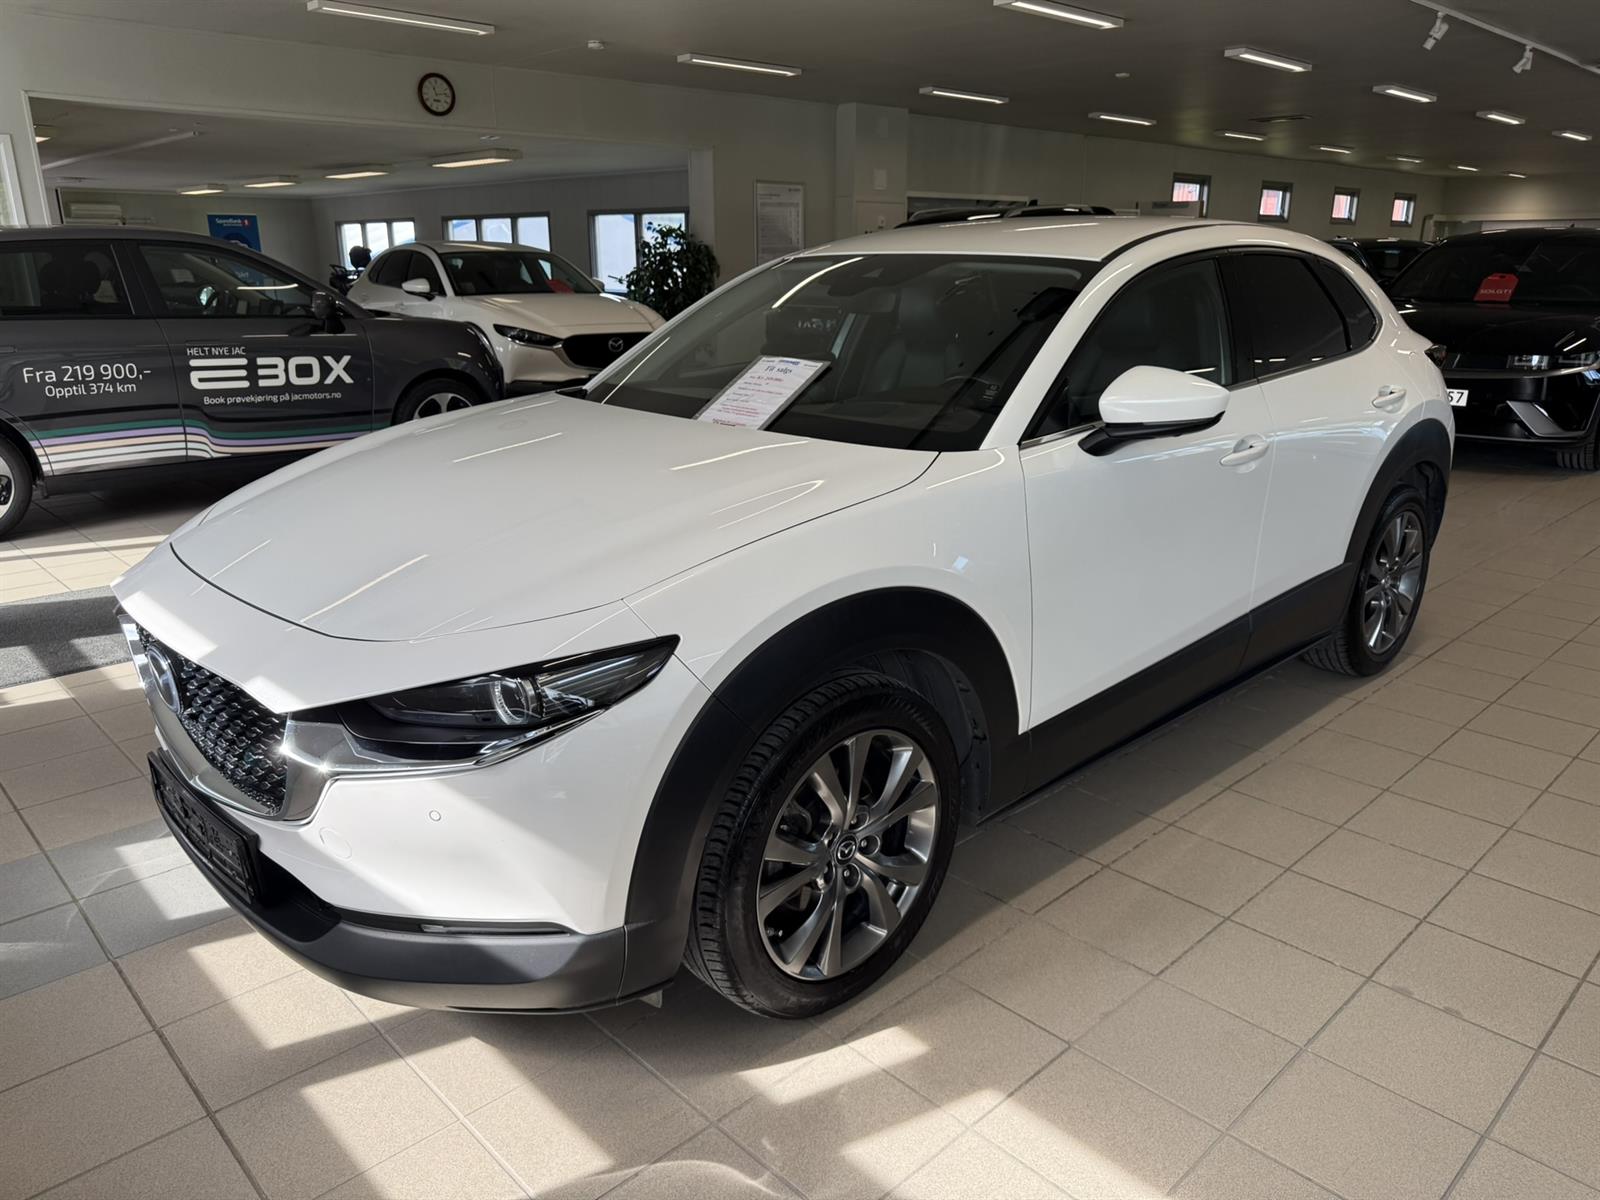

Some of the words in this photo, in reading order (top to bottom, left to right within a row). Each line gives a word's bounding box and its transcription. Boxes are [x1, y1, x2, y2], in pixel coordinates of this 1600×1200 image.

[186, 347, 209, 356] HELT
[211, 346, 230, 355] NYE
[231, 346, 247, 355] JAC
[22, 367, 57, 383] Fra
[61, 364, 95, 381] 219
[99, 362, 152, 380] 900,-
[44, 384, 87, 399] Opptil
[89, 382, 114, 395] 374
[116, 382, 137, 393] km
[203, 396, 226, 405] Book
[226, 393, 279, 405] prøvekjøring
[279, 392, 290, 402] på
[291, 391, 342, 401] jacmotors.no
